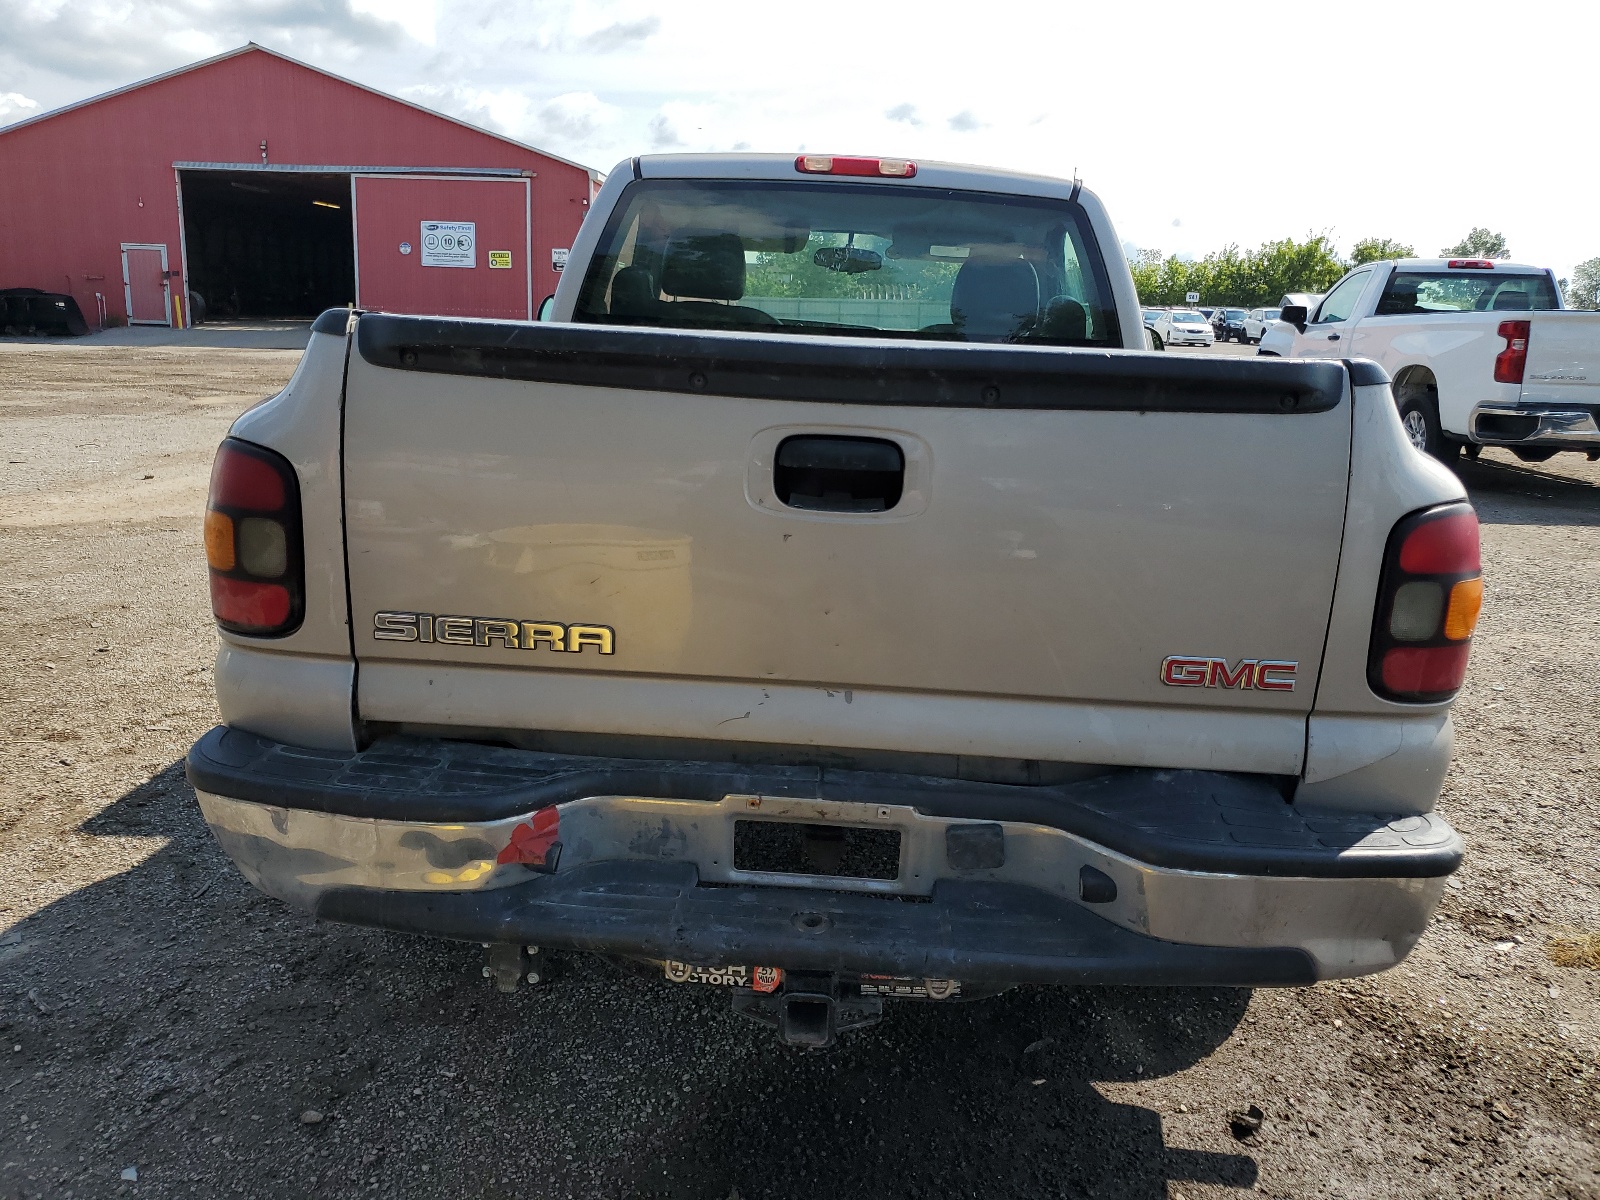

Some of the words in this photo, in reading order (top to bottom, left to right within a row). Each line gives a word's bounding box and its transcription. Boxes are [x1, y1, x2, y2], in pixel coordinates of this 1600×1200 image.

[444, 238, 453, 246] 10
[374, 610, 616, 656] SIERRA
[1160, 654, 1299, 692] GMC
